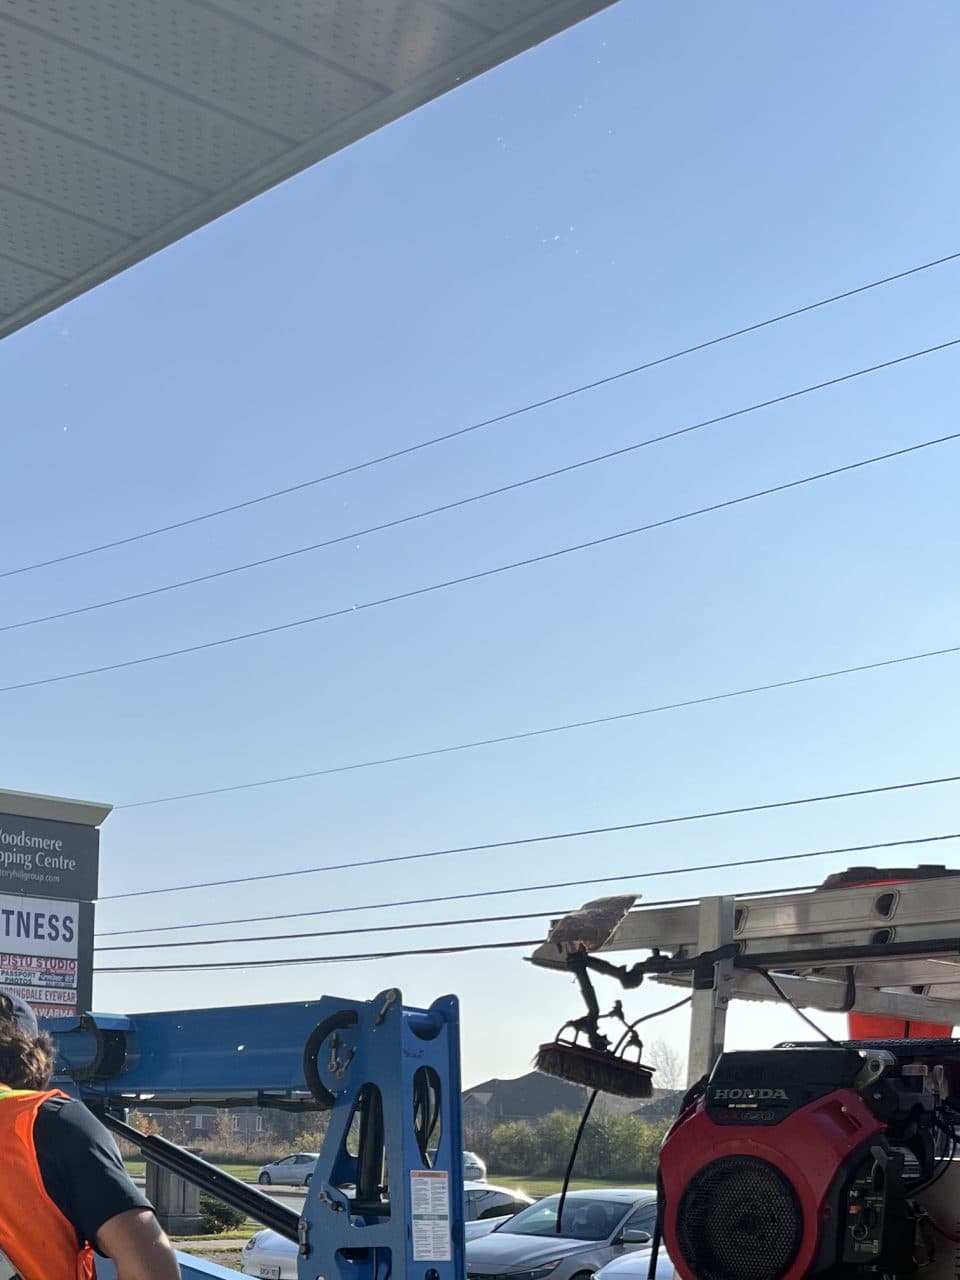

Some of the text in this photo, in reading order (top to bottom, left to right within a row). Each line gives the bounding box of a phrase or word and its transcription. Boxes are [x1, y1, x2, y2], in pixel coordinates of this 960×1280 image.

[35, 851, 76, 871] Centre
[37, 958, 76, 970] STUDIO
[0, 969, 36, 978] PASSPORT
[5, 977, 32, 985] PHOTOS
[45, 990, 76, 1003] EYEWEAR
[713, 1088, 790, 1100] HONDA
